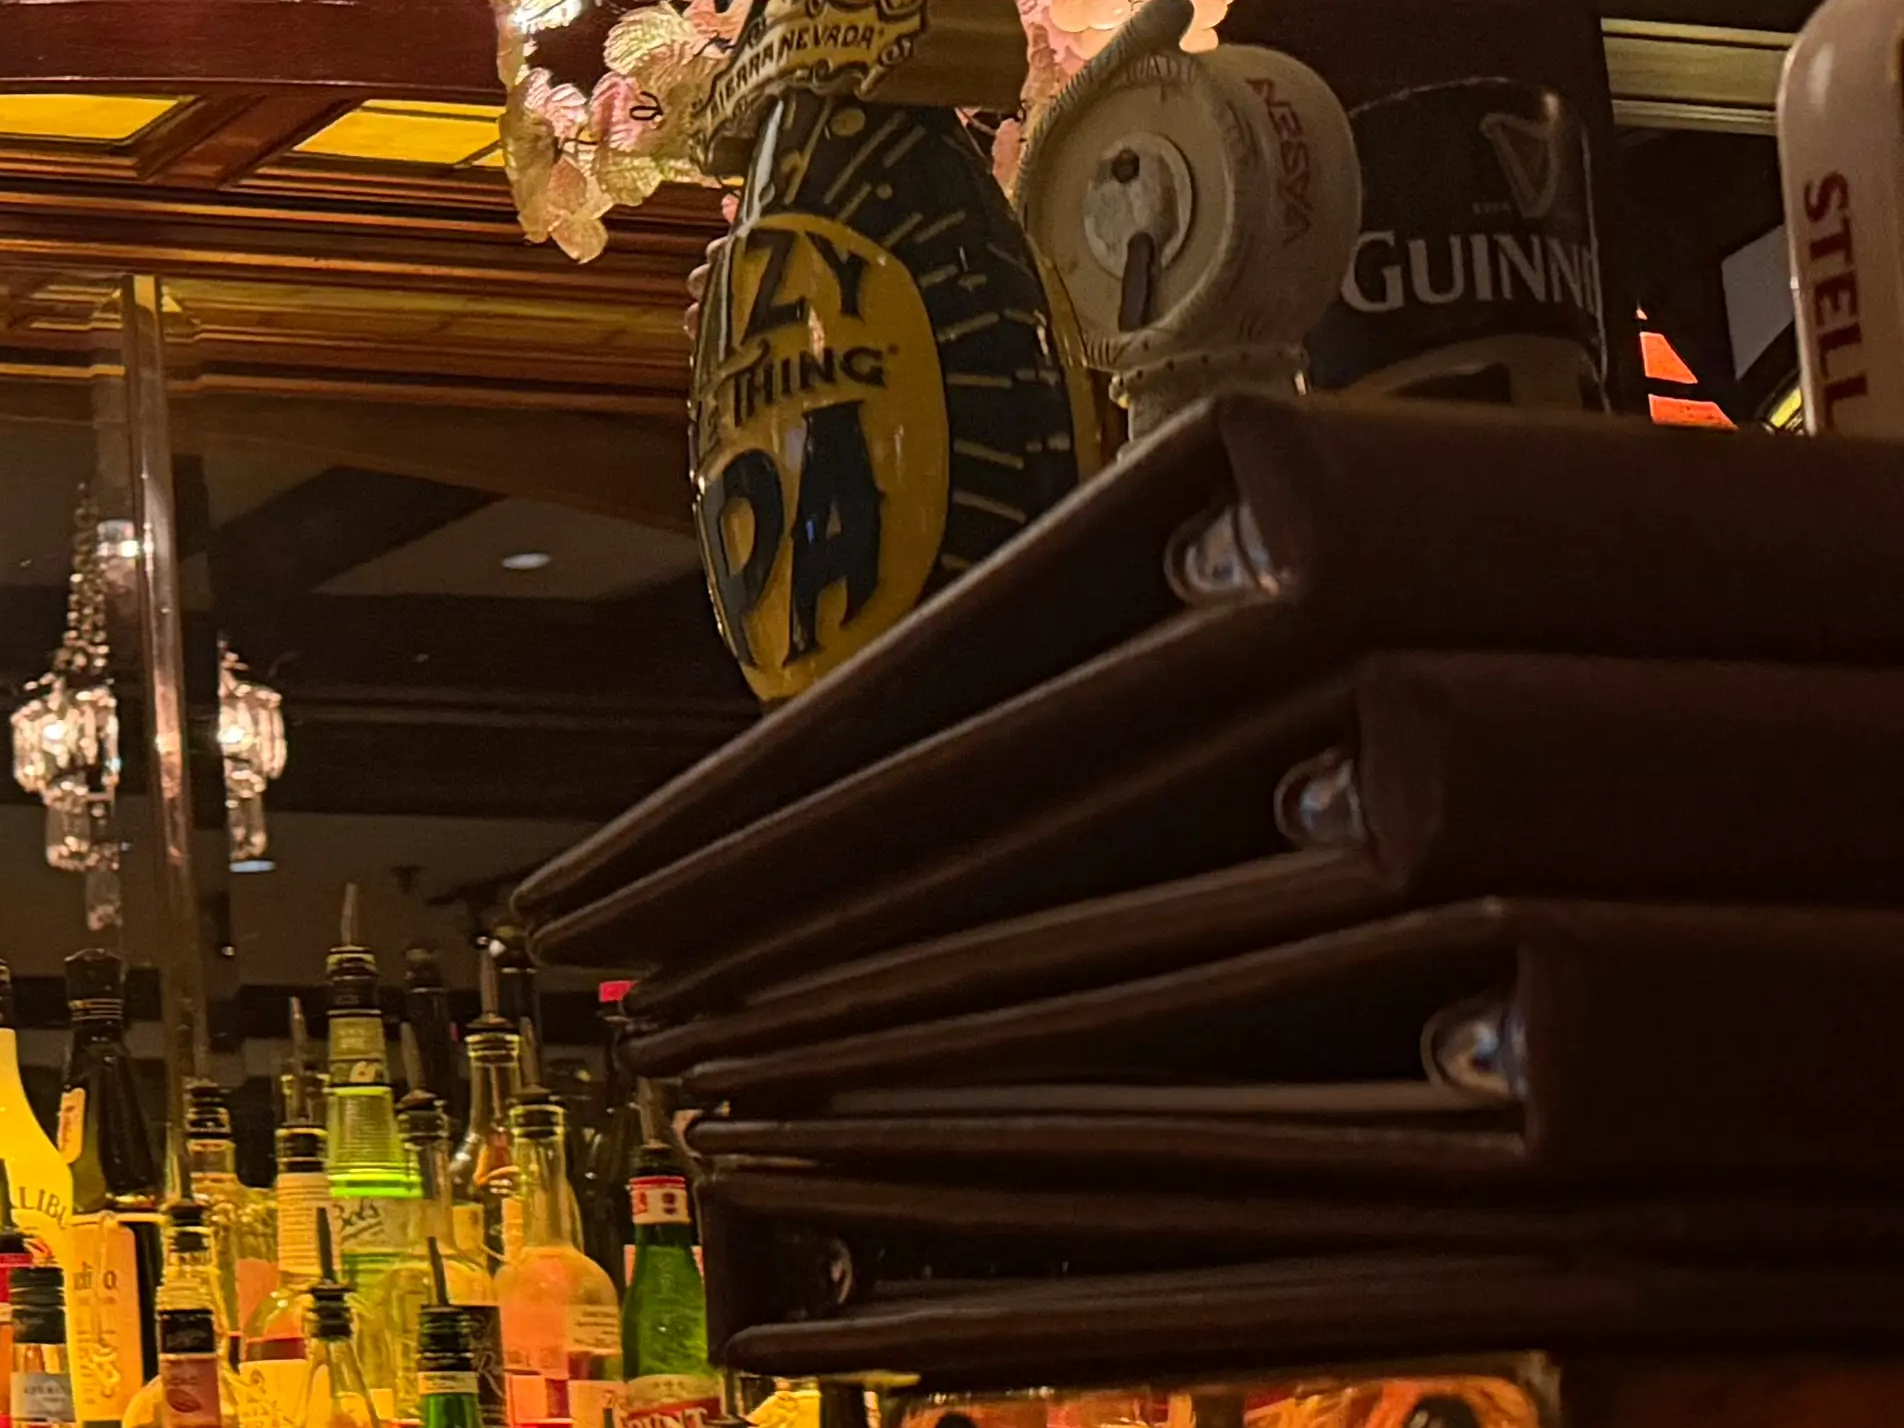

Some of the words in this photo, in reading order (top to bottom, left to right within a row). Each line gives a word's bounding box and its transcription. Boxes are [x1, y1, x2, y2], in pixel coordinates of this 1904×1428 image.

[778, 25, 877, 60] NEVADA
[744, 225, 869, 335] ZY
[697, 402, 884, 670] PA
